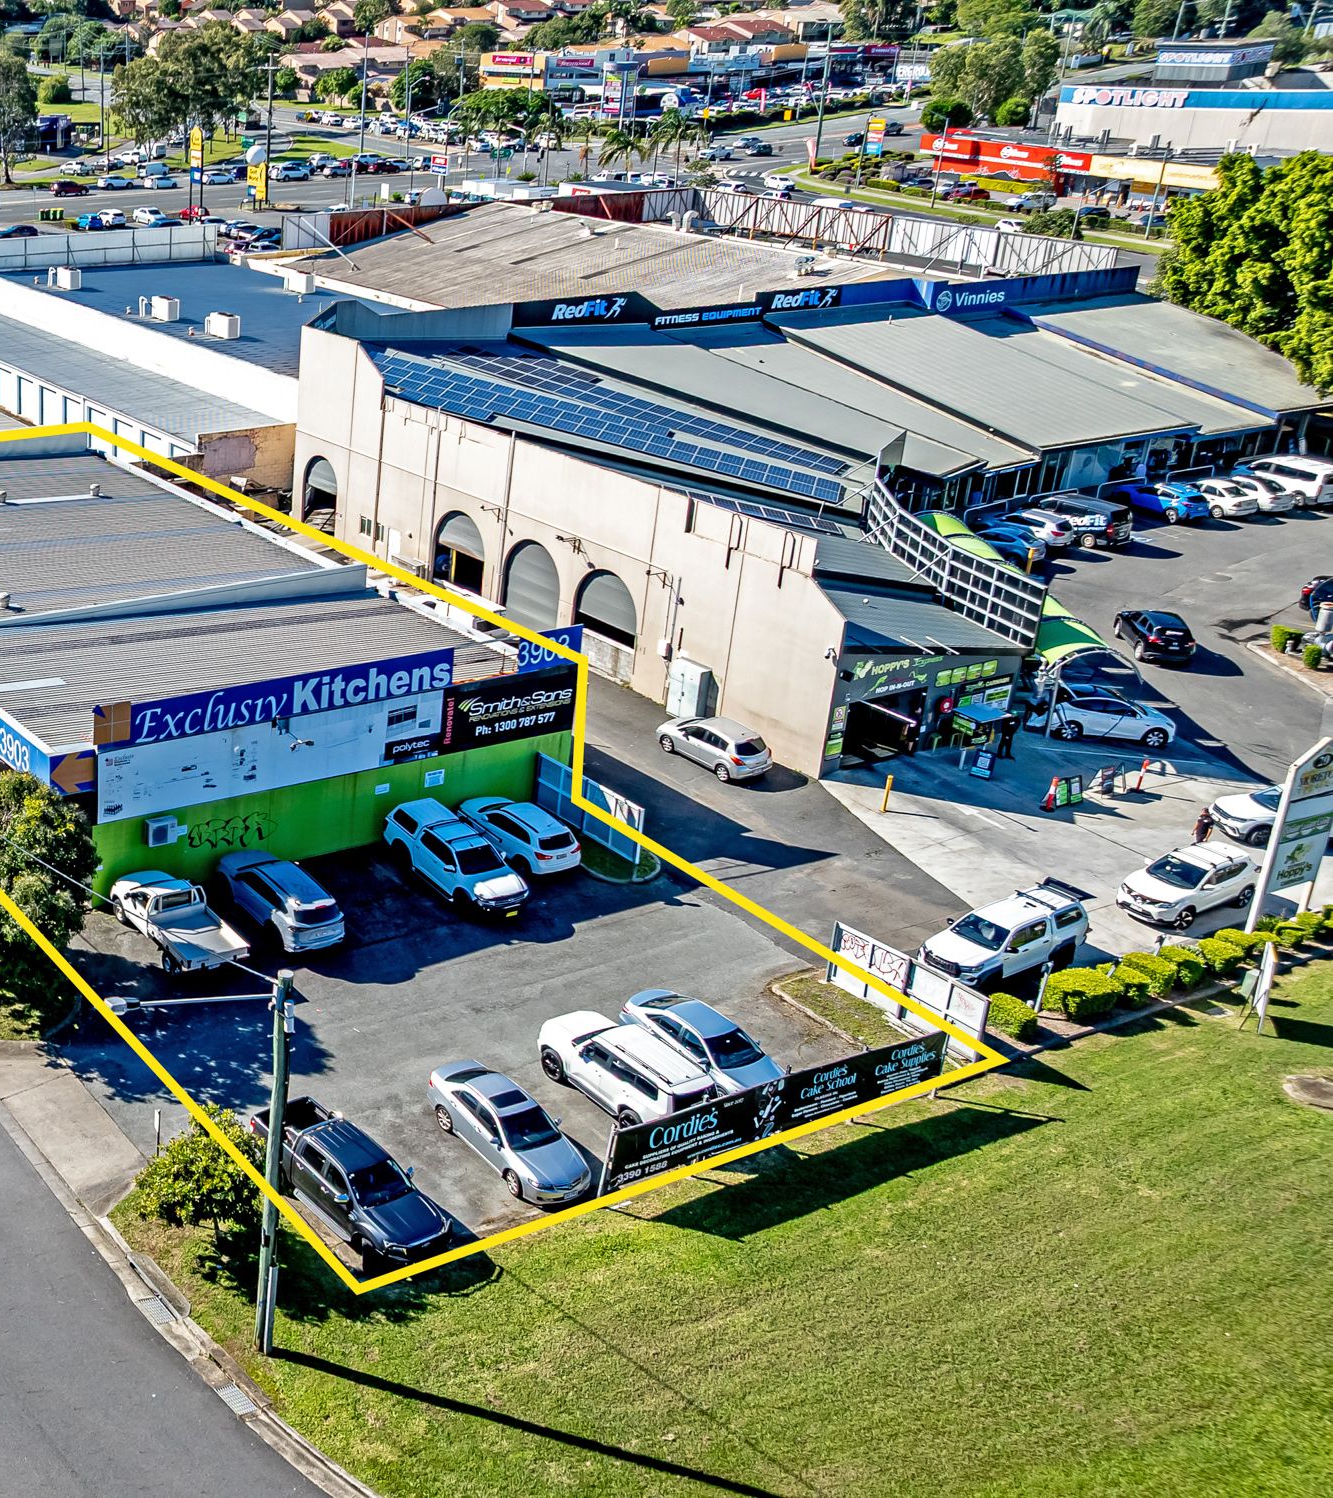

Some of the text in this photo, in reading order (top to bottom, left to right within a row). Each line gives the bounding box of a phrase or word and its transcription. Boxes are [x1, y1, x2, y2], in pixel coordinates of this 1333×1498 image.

[1158, 52, 1233, 63] SPOTLIGHT
[1072, 88, 1189, 108] SPOTLIGHT
[551, 299, 608, 320] RedFit
[771, 290, 821, 309] RedFit
[955, 290, 1006, 308] Vinnies
[655, 306, 763, 326] FITNESS EQUIPMENT
[871, 658, 910, 675] HOPPY'S
[291, 662, 452, 714] Kitchens
[875, 684, 889, 694] HOP
[468, 697, 572, 723] RENOVATIONS & EXTENSIONS
[443, 697, 456, 745] Renovate!
[475, 711, 556, 736] Ph: 1300 787 577
[0, 727, 30, 773] 3903
[392, 740, 430, 755] polytec
[1276, 864, 1313, 880] Hoppy's
[874, 1050, 937, 1077] Cake Supplies
[800, 1083, 825, 1100] Cake
[826, 1072, 858, 1093] School
[649, 1106, 719, 1149] Cordie's
[624, 1161, 639, 1170] CAKE
[639, 1152, 670, 1167] DECORATING
[671, 1143, 698, 1156] EQUIPMENT
[642, 1147, 670, 1159] SUPPLIERS
[677, 1137, 697, 1149] QUALITY
[617, 1169, 642, 1184] 3390
